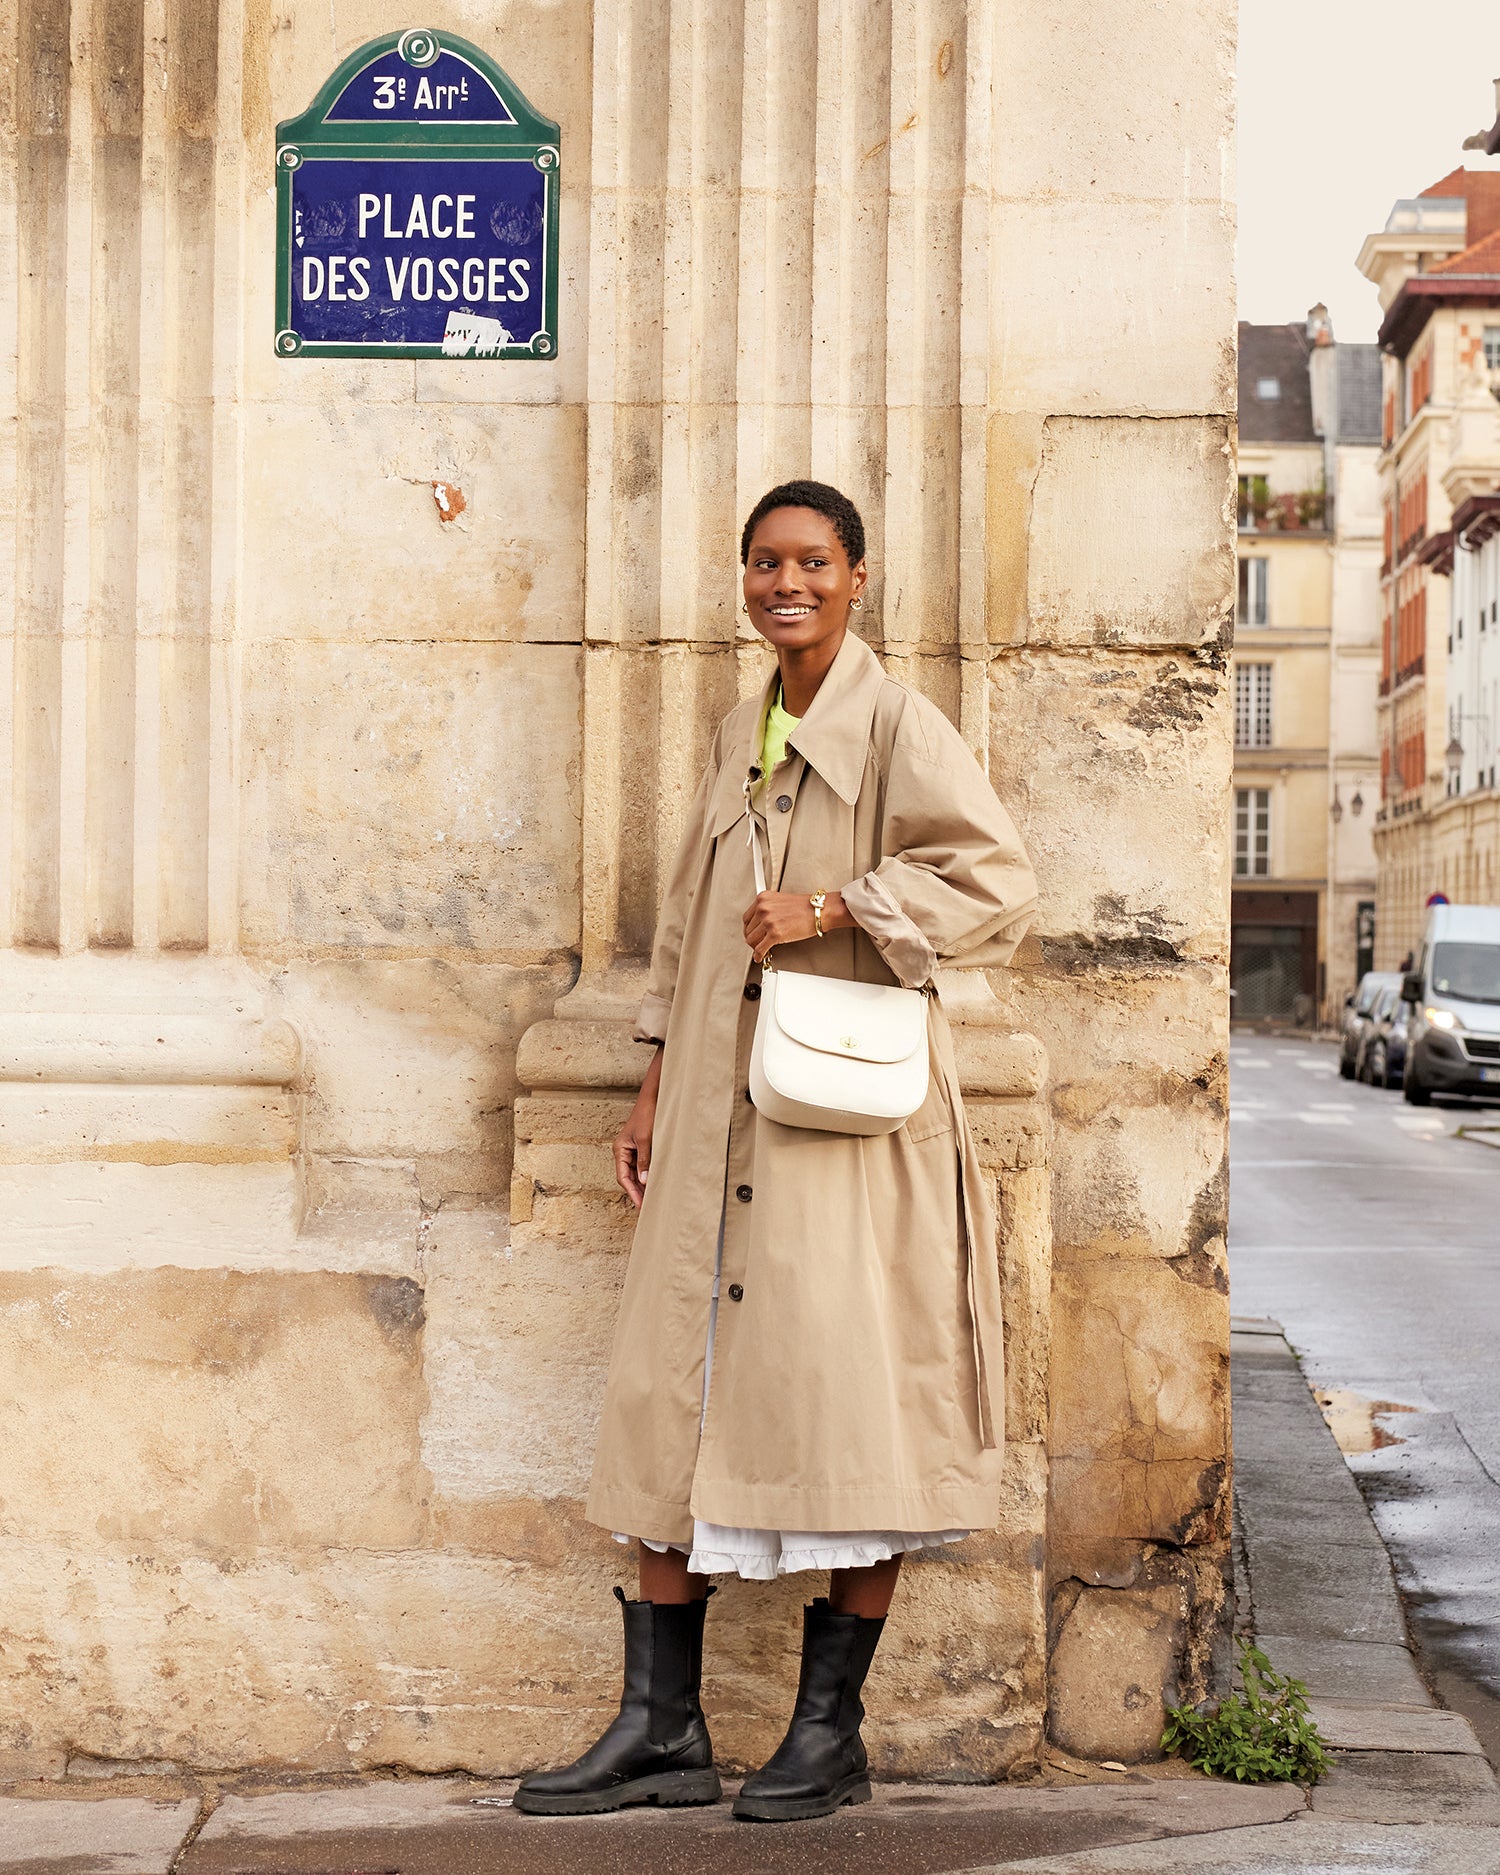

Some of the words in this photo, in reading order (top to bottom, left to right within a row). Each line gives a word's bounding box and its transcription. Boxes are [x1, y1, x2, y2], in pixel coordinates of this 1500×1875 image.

[358, 193, 476, 239] PLACE
[302, 256, 371, 302] DES
[385, 256, 530, 302] VOSGES
